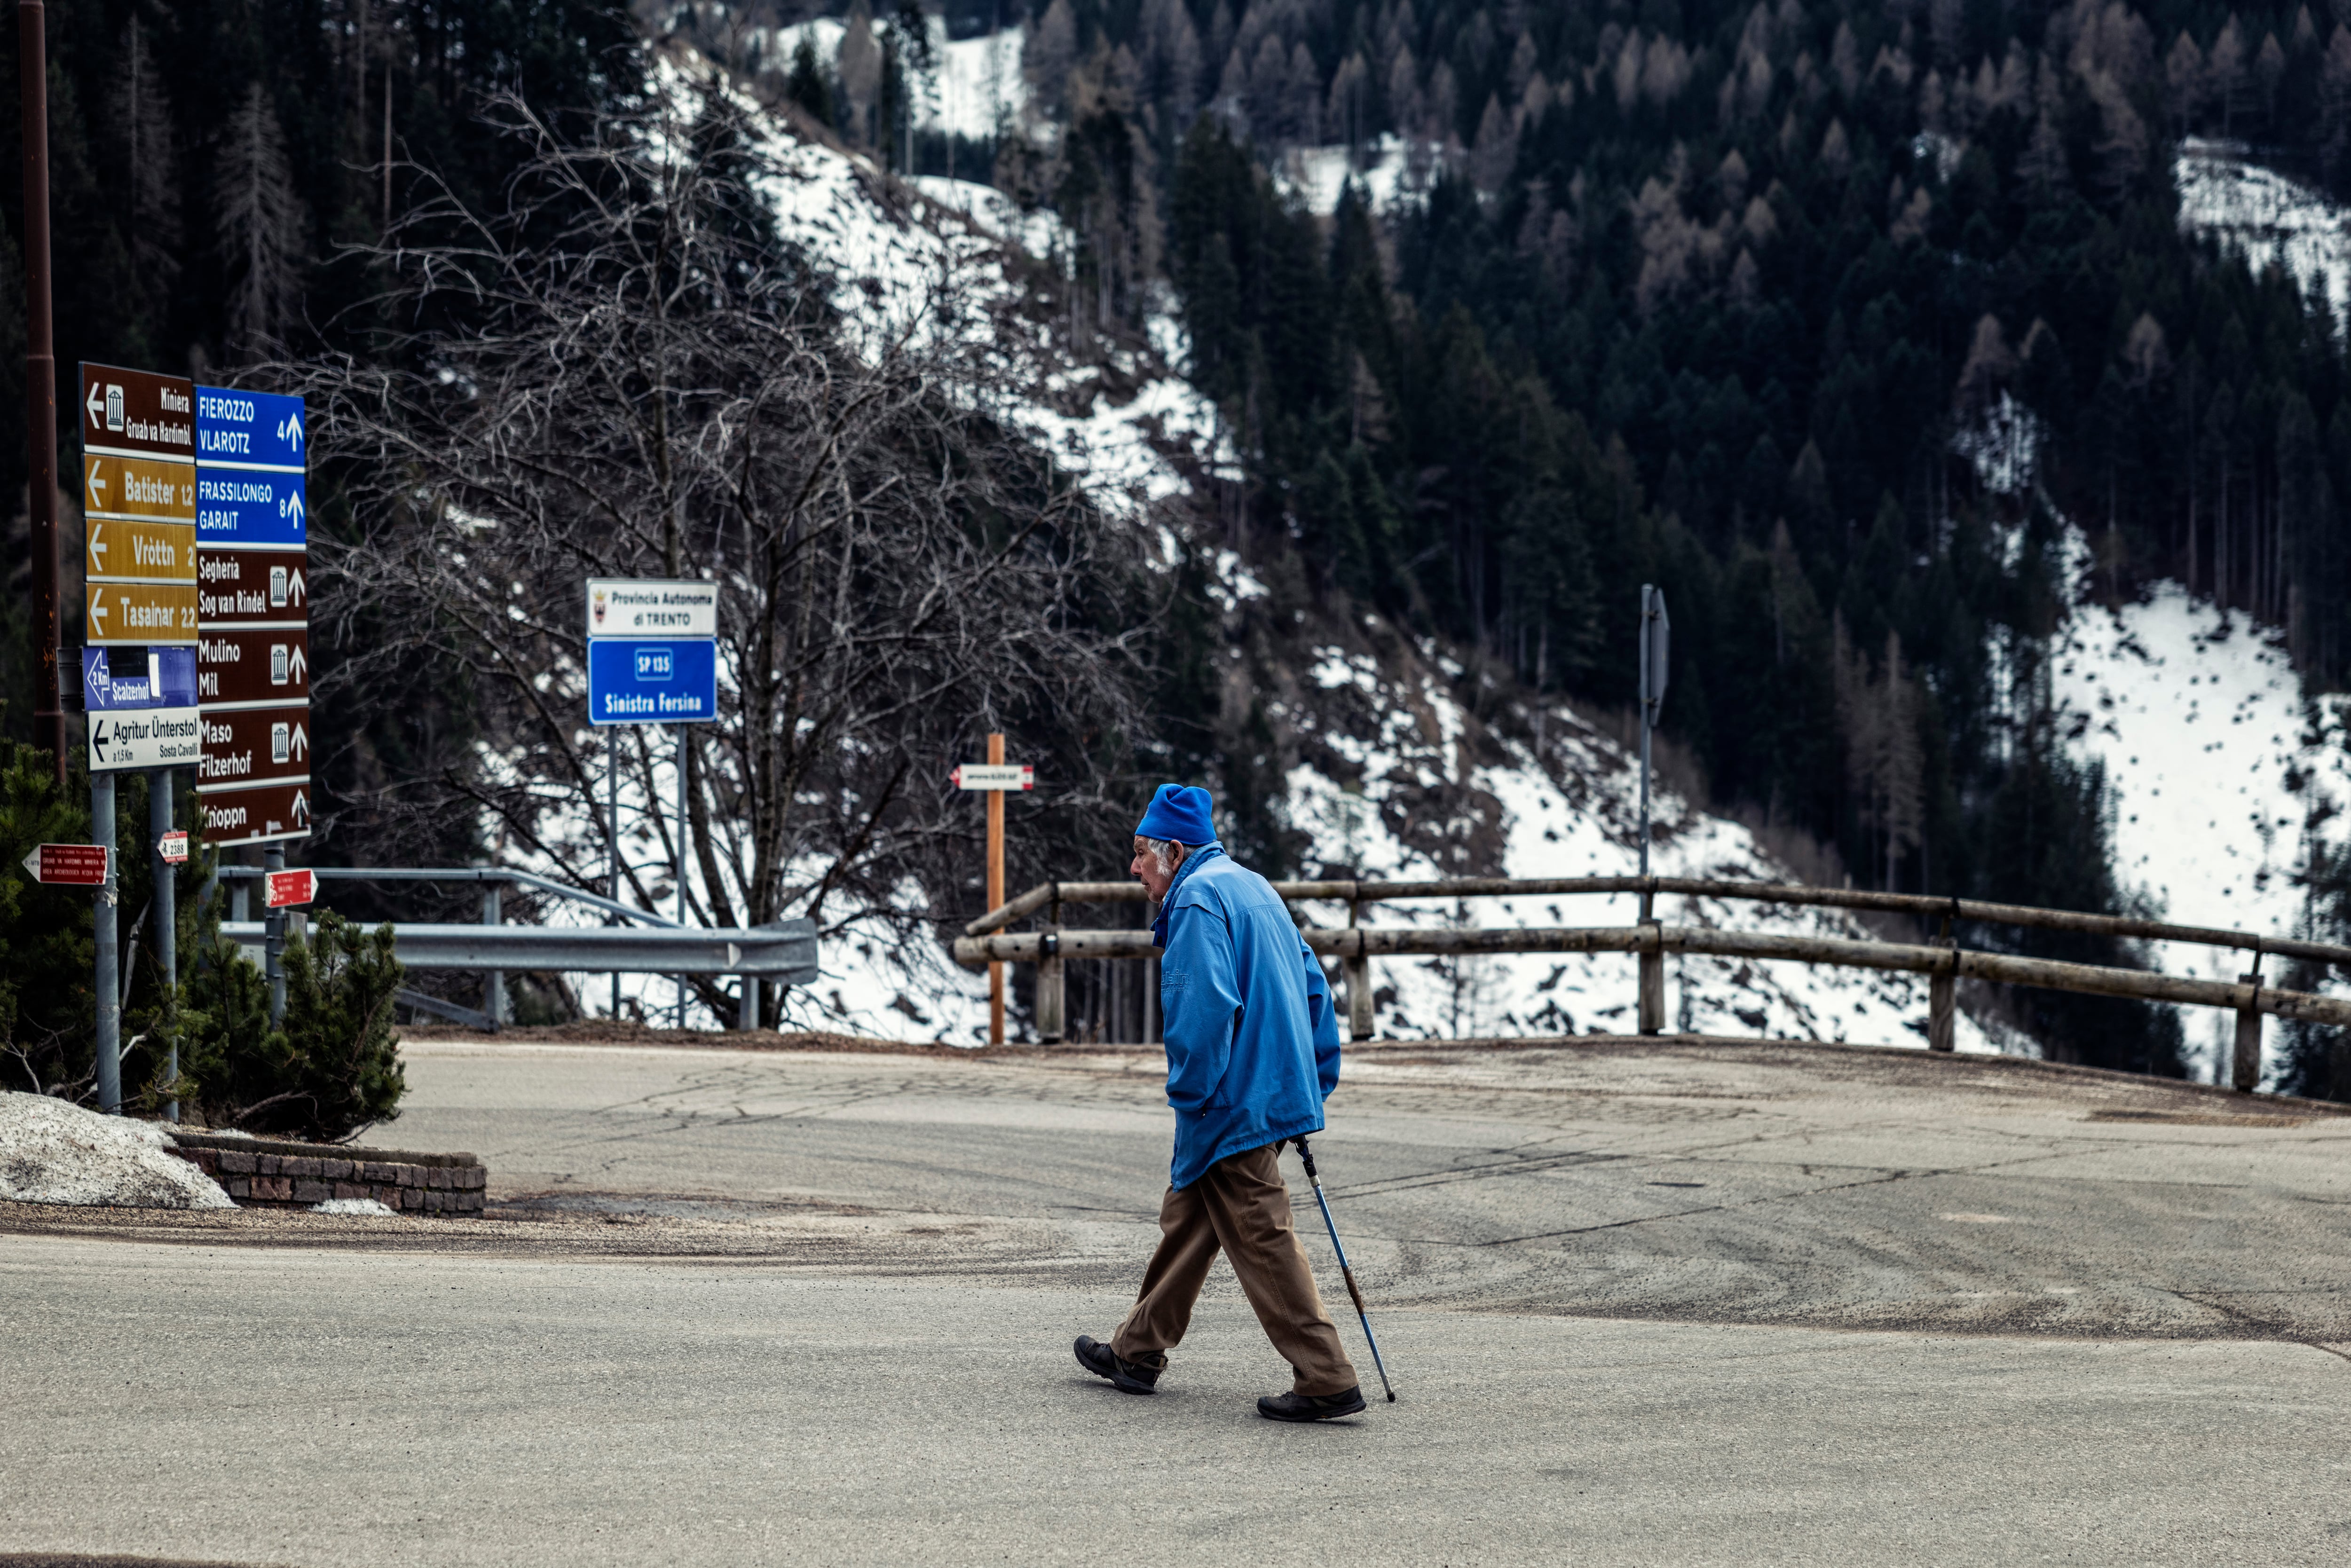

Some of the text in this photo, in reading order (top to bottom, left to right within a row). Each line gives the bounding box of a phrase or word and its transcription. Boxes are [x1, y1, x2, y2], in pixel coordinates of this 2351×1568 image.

[161, 386, 189, 413] Miniera
[199, 396, 254, 422] FIEROZZO
[126, 415, 191, 446] Gruab va Hardimbl
[200, 428, 250, 454] VLAROTZ
[277, 420, 284, 441] 4
[125, 471, 174, 504] Batister
[199, 481, 272, 503] FRASSILONGO
[280, 497, 286, 518] 8
[199, 510, 238, 530] GARAIT
[133, 535, 193, 567] Vròttn 2
[199, 555, 239, 583] Segheria
[199, 589, 267, 617] Sog van Rindel
[612, 592, 712, 605] Provincia Autonoma
[120, 597, 174, 627] Tasainar
[634, 613, 690, 626] di TRENTO
[199, 638, 240, 663] Mulino
[638, 656, 651, 673] SP
[93, 671, 108, 686] 2 Km
[199, 671, 219, 696] Mil
[112, 681, 149, 701] Scalzerhof
[605, 692, 702, 714] Sinistra Fersina
[113, 715, 197, 745] Agritur Ünterstol
[200, 720, 232, 744] Maso
[113, 752, 116, 762] a
[125, 749, 133, 761] Km
[160, 741, 197, 758] Sosta Cavalli
[199, 749, 252, 778] Filzerhof
[170, 843, 183, 855] 2388
